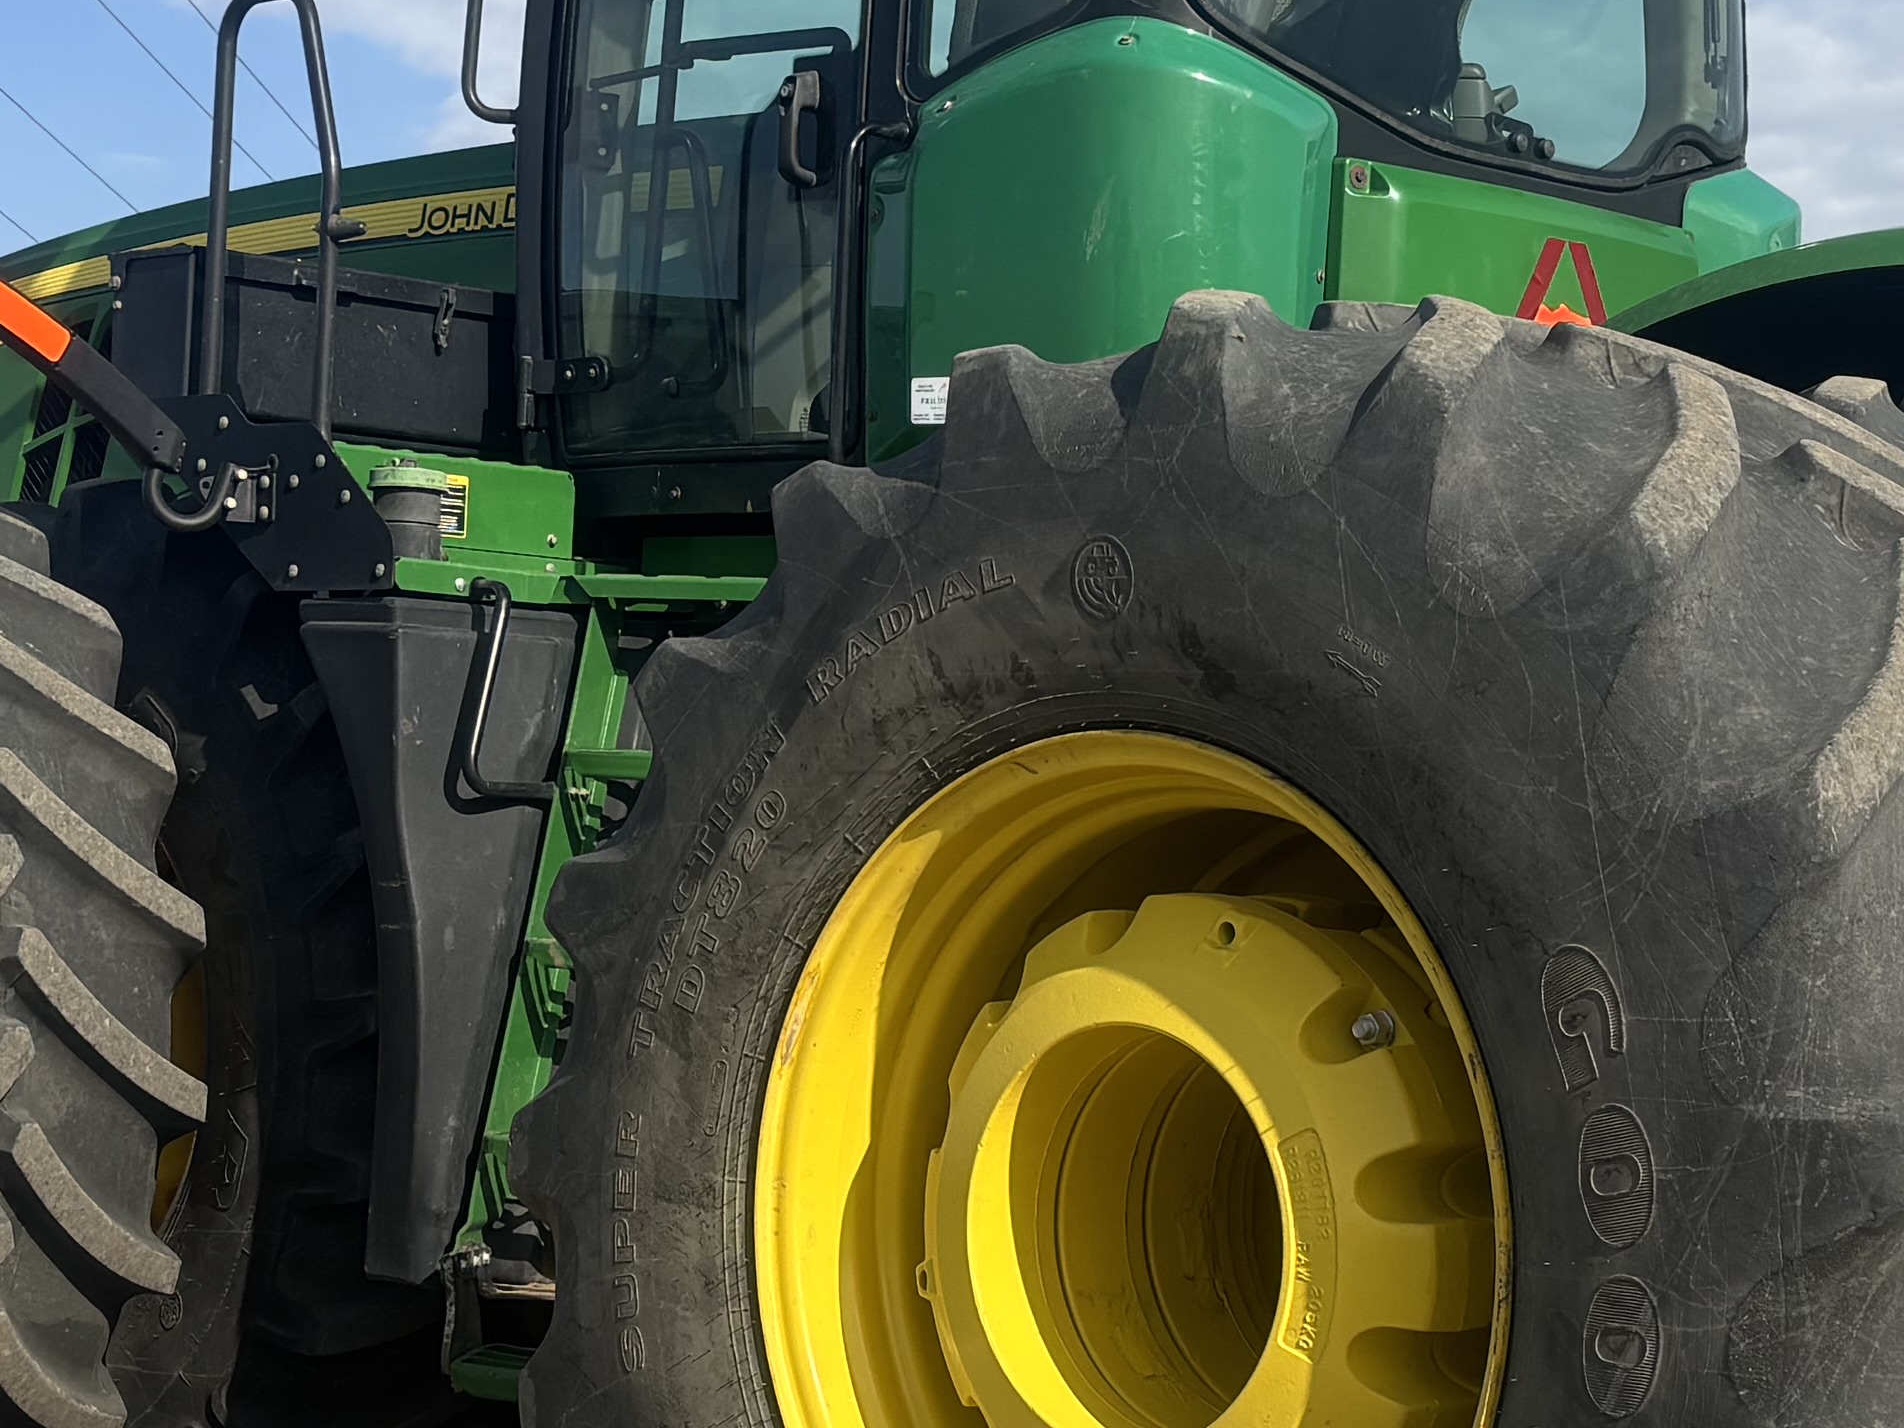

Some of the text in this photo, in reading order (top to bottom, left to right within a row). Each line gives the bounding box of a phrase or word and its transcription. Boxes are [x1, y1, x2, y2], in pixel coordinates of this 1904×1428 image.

[407, 201, 497, 235] JOHN
[612, 556, 1016, 1373] SUPER TRACTION RADIAL
[673, 789, 787, 1014] DT820
